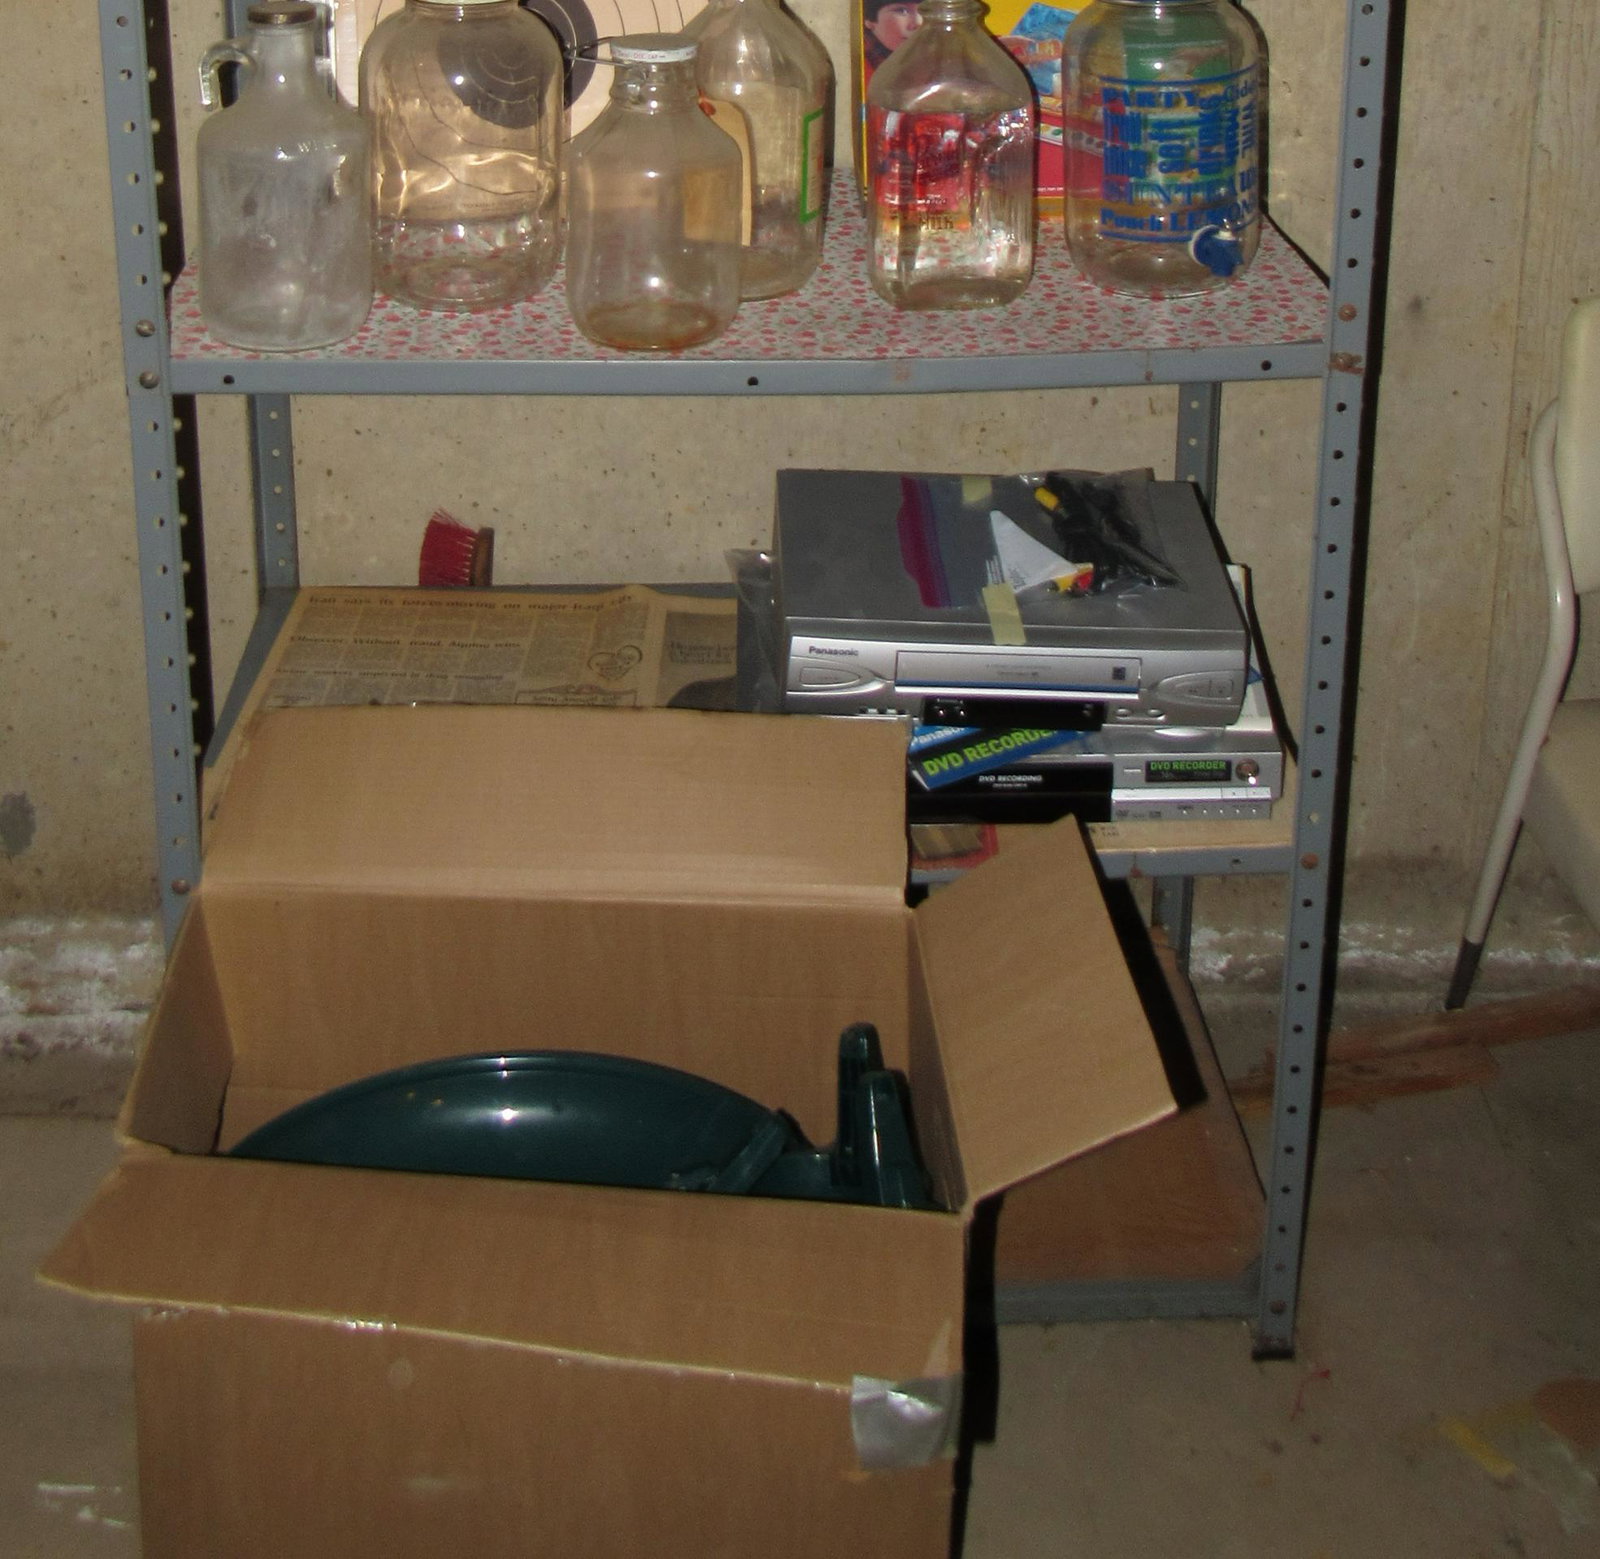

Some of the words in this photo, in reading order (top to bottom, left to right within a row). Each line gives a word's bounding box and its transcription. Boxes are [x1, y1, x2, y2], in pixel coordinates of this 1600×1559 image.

[808, 645, 860, 657] Panasonic
[922, 752, 964, 777] DVD
[963, 728, 1060, 763] RECORDE
[1149, 760, 1170, 771] DVD
[1171, 760, 1227, 771] RECORDER
[978, 775, 996, 783] DVD
[997, 775, 1043, 783] RECORDING
